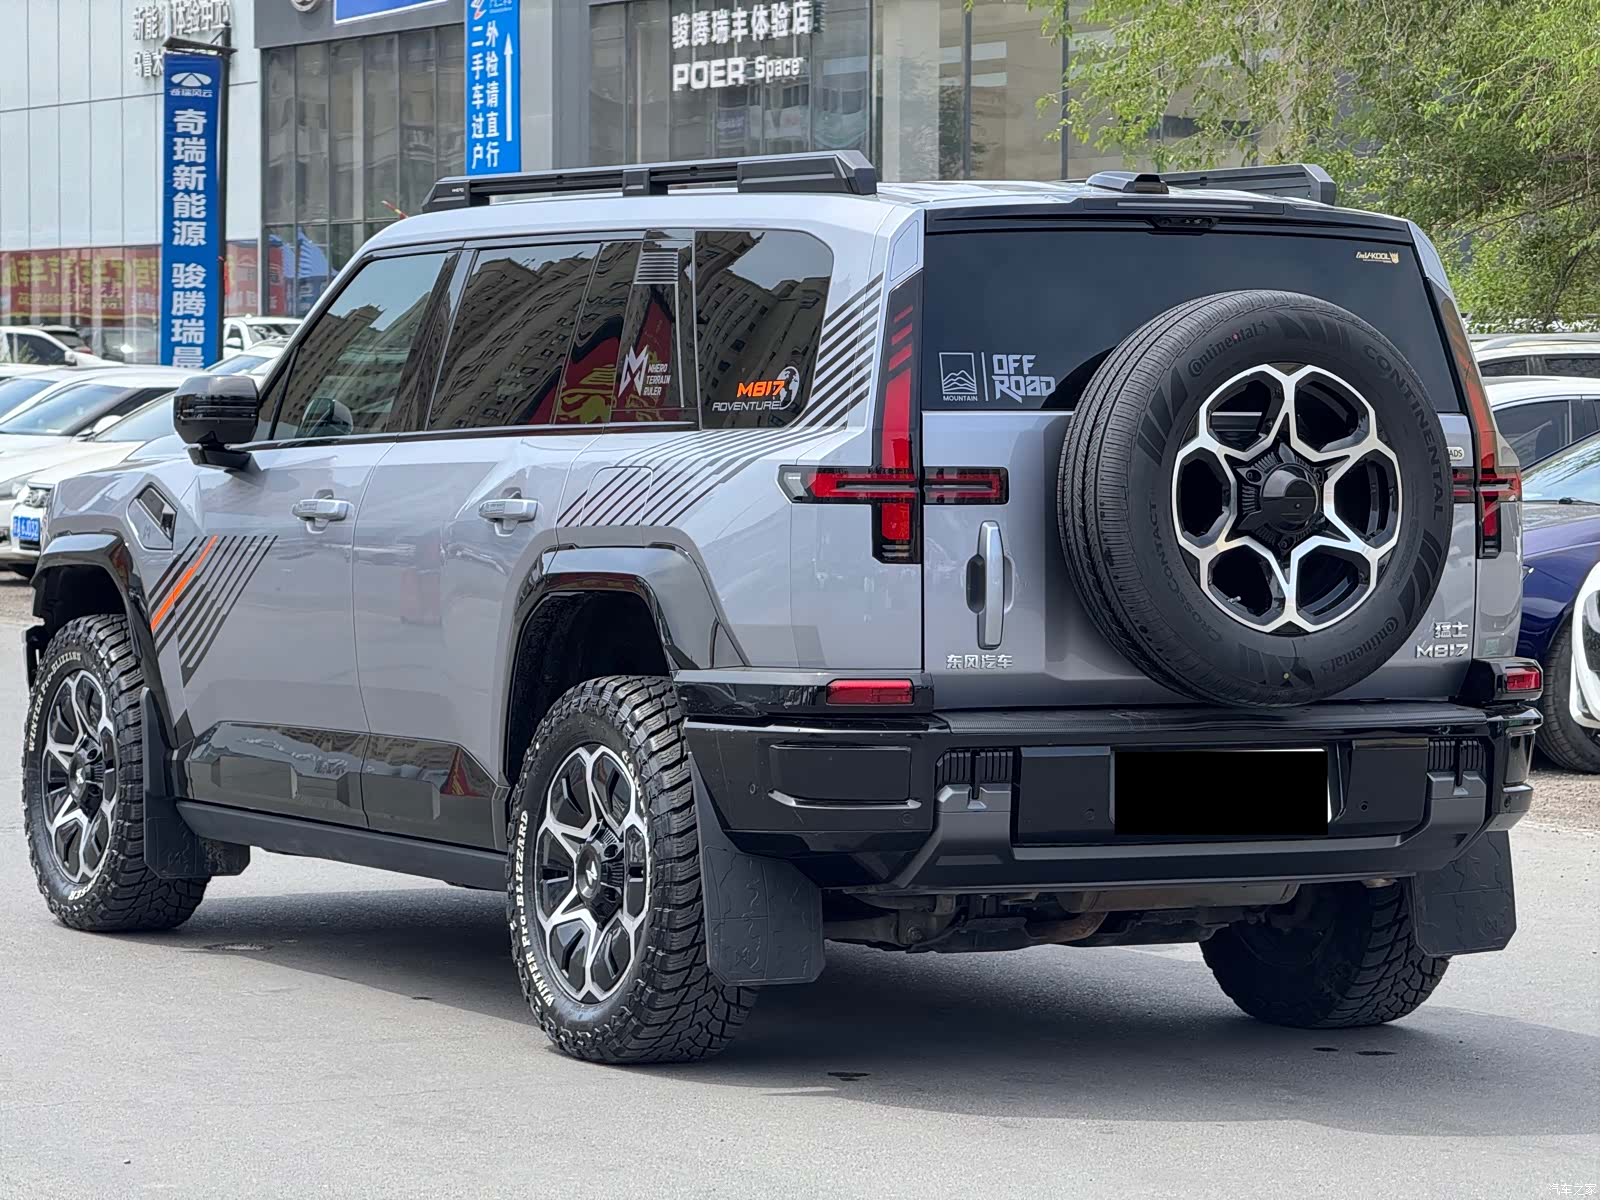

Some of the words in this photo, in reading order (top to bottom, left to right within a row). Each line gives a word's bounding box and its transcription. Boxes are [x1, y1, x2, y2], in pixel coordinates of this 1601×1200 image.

[672, 1, 813, 49] 骏腾瑞丰体验店
[485, 20, 500, 168] 外检请直行
[673, 57, 746, 91] POER
[755, 55, 804, 83] Space
[471, 25, 484, 169] 二手车过户
[172, 109, 208, 246] 奇瑞新能源
[992, 354, 1036, 375] OFF
[1188, 322, 1260, 377] Continental
[643, 386, 662, 396] RULER
[646, 375, 672, 384] TERRAIN
[736, 380, 785, 398] M817
[711, 400, 782, 411] ADVENTURE
[1363, 344, 1444, 521] CONTINENTAL
[1416, 643, 1469, 658] M817
[1434, 621, 1469, 639] 猛士
[946, 653, 1013, 670] 东风汽车
[28, 693, 44, 752] WINTER
[515, 809, 531, 948] Pro-BLIZZARD
[525, 951, 555, 1008] WINTER
